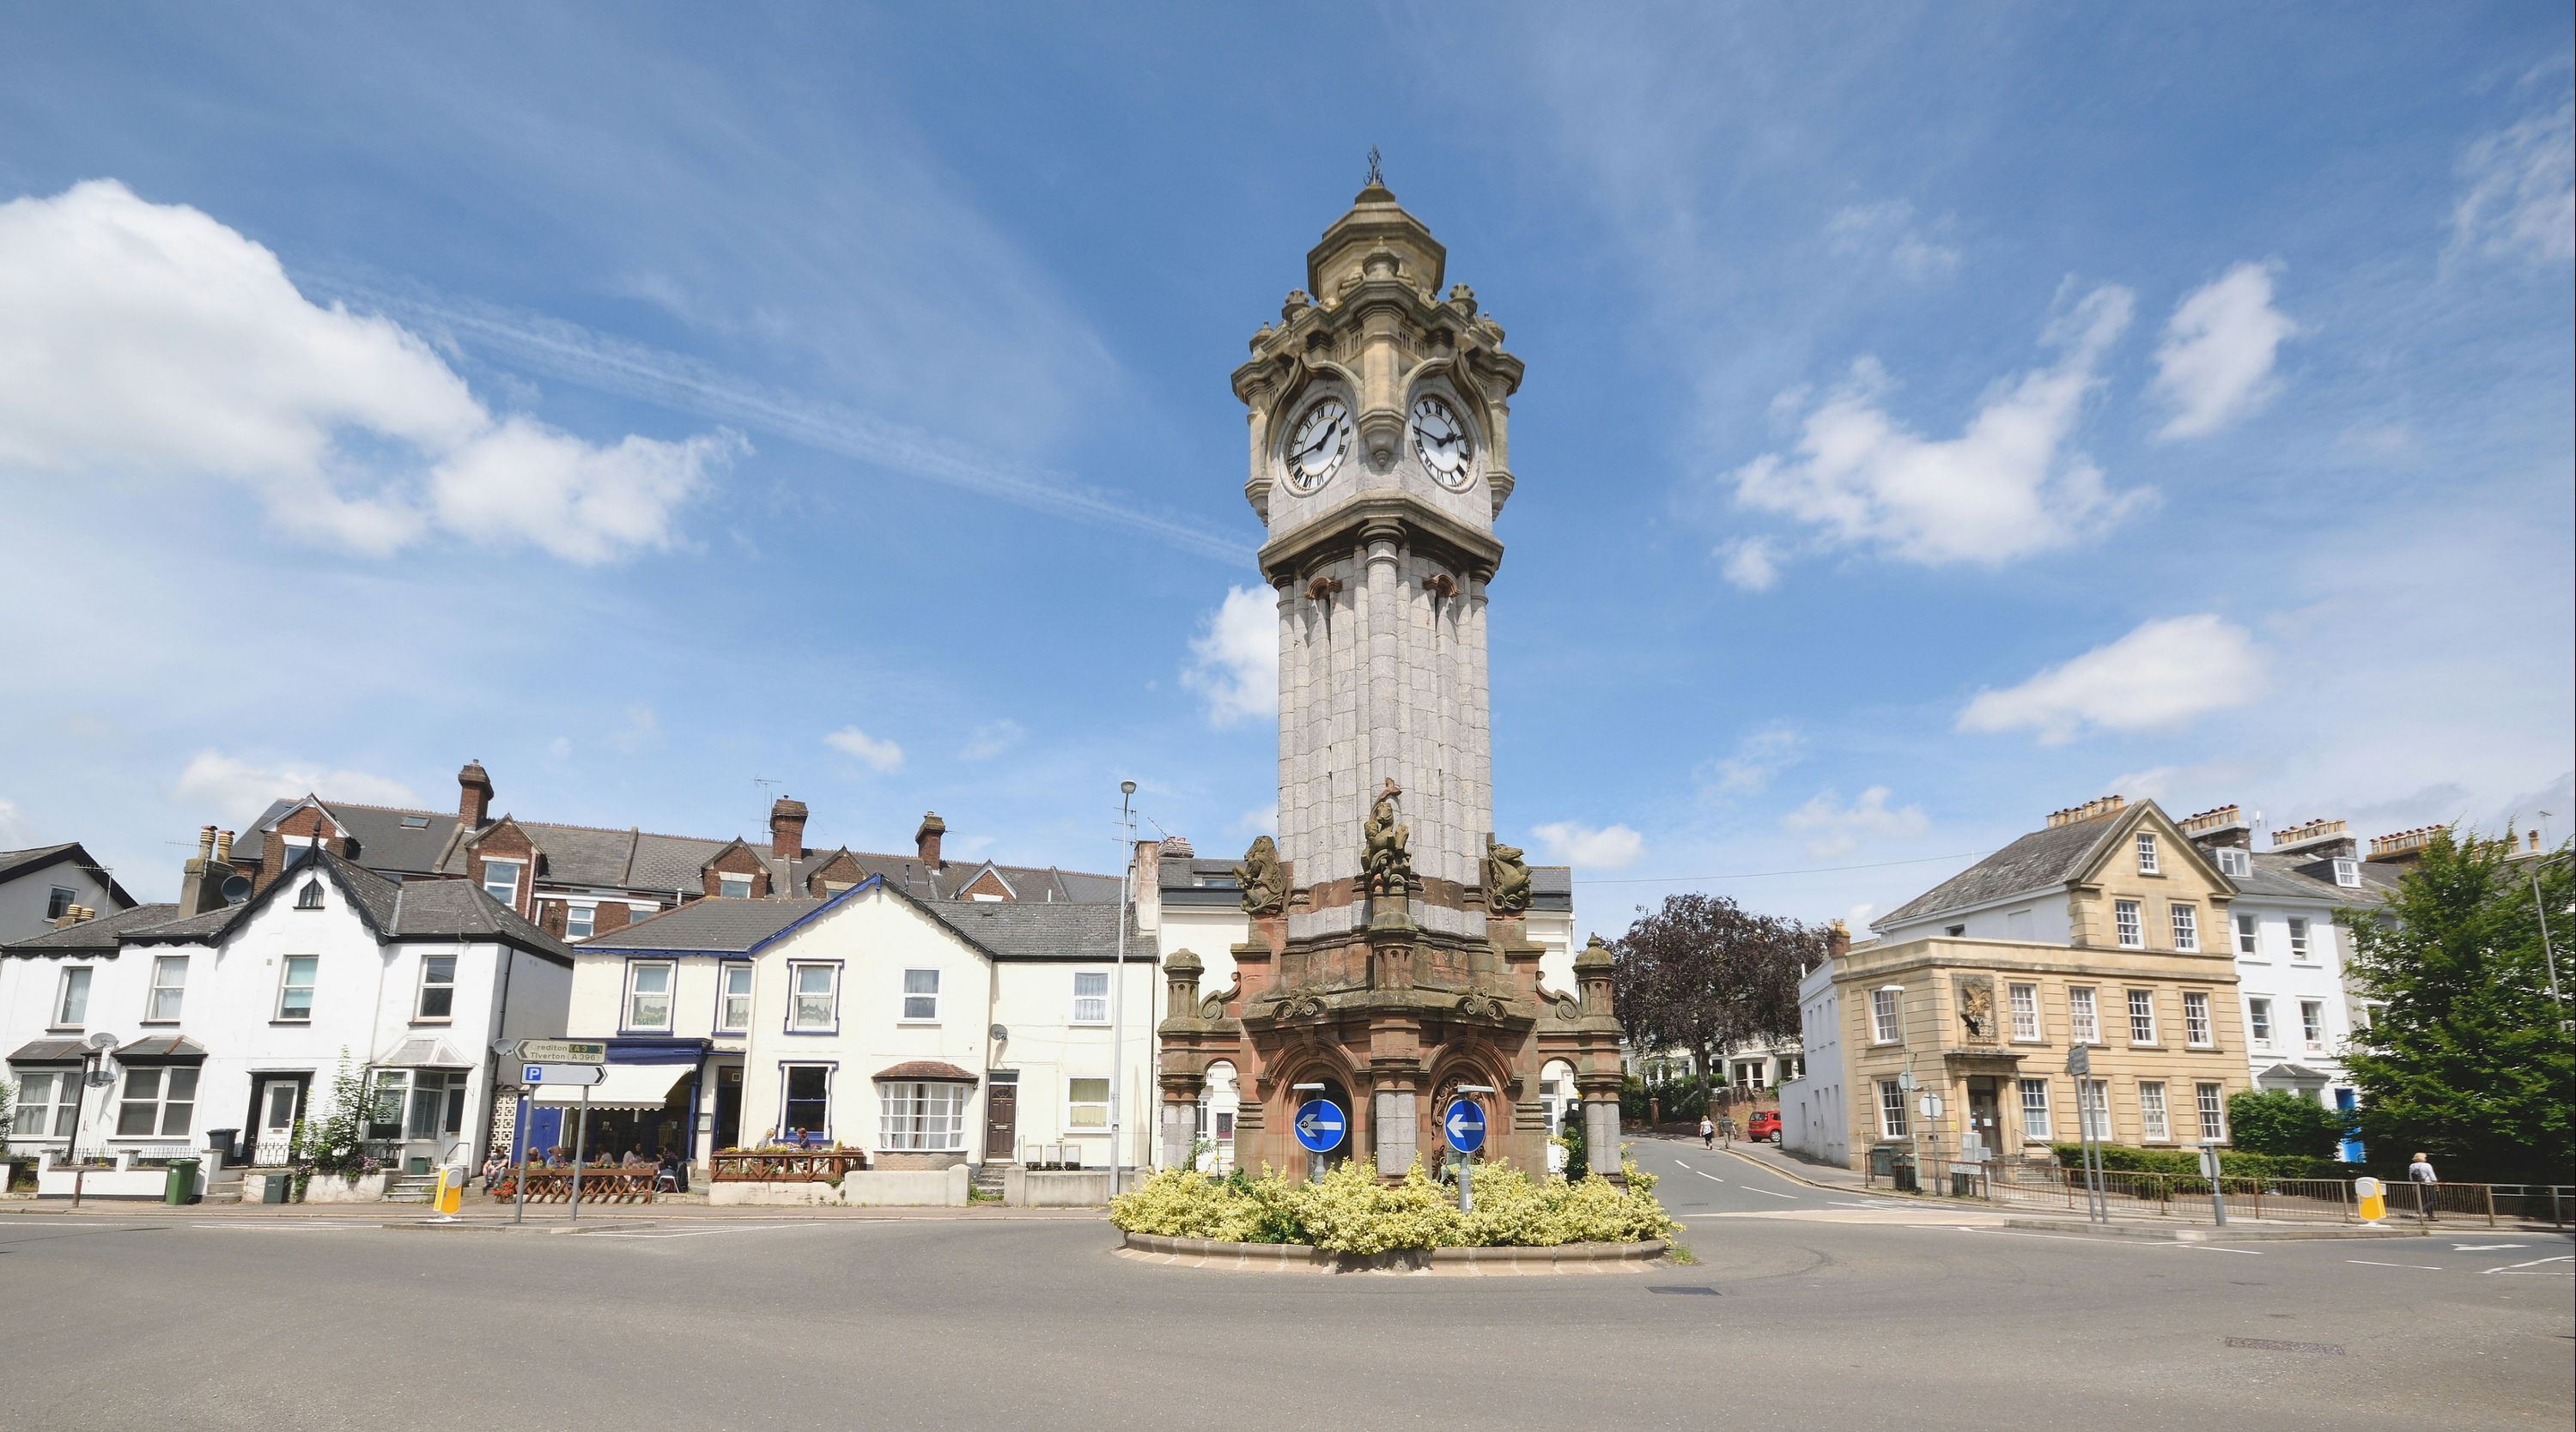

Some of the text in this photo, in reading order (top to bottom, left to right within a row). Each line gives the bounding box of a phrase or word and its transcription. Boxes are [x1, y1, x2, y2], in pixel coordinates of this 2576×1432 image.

[1316, 405, 1325, 421] XII
[1330, 404, 1336, 417] I
[1304, 419, 1313, 432] XI
[1449, 416, 1454, 425] I
[530, 1052, 566, 1060] Tiverton
[529, 1068, 540, 1080] P
